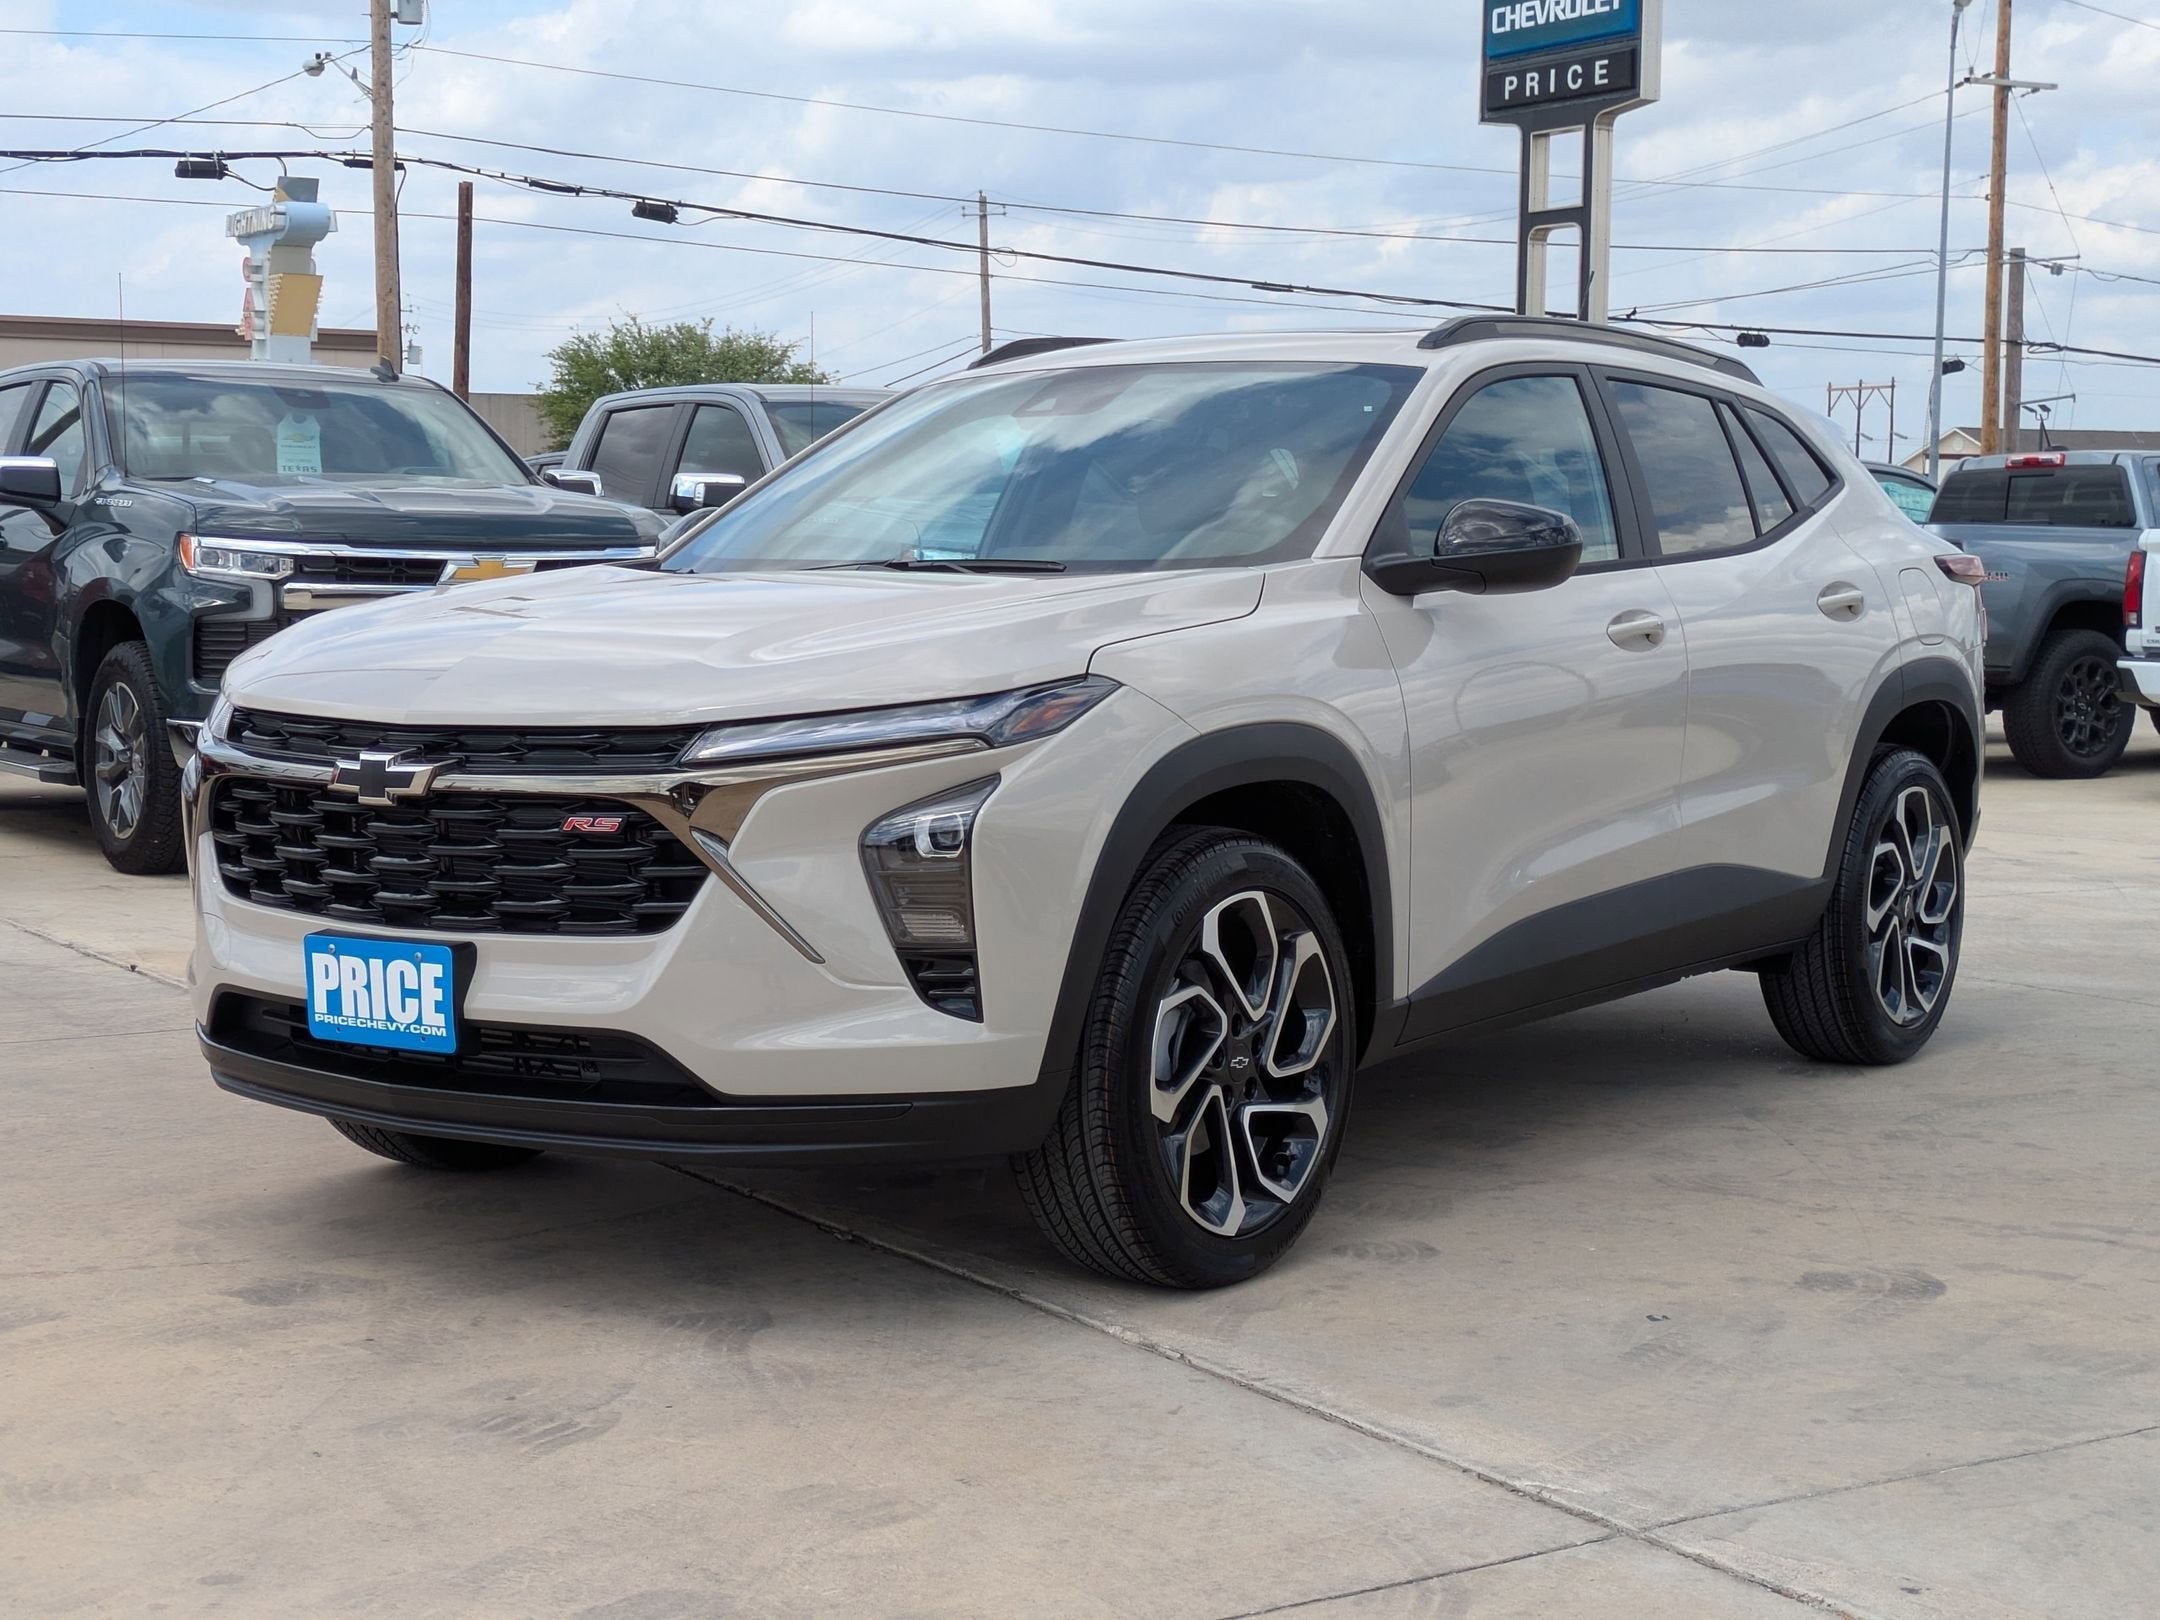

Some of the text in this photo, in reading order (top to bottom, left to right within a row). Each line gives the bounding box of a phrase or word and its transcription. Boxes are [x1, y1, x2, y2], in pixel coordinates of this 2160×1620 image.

[1504, 59, 1609, 100] PRICE
[562, 816, 623, 832] RS
[311, 952, 446, 1027] PRICE
[314, 1013, 447, 1037] PRICECHEVY.COM
